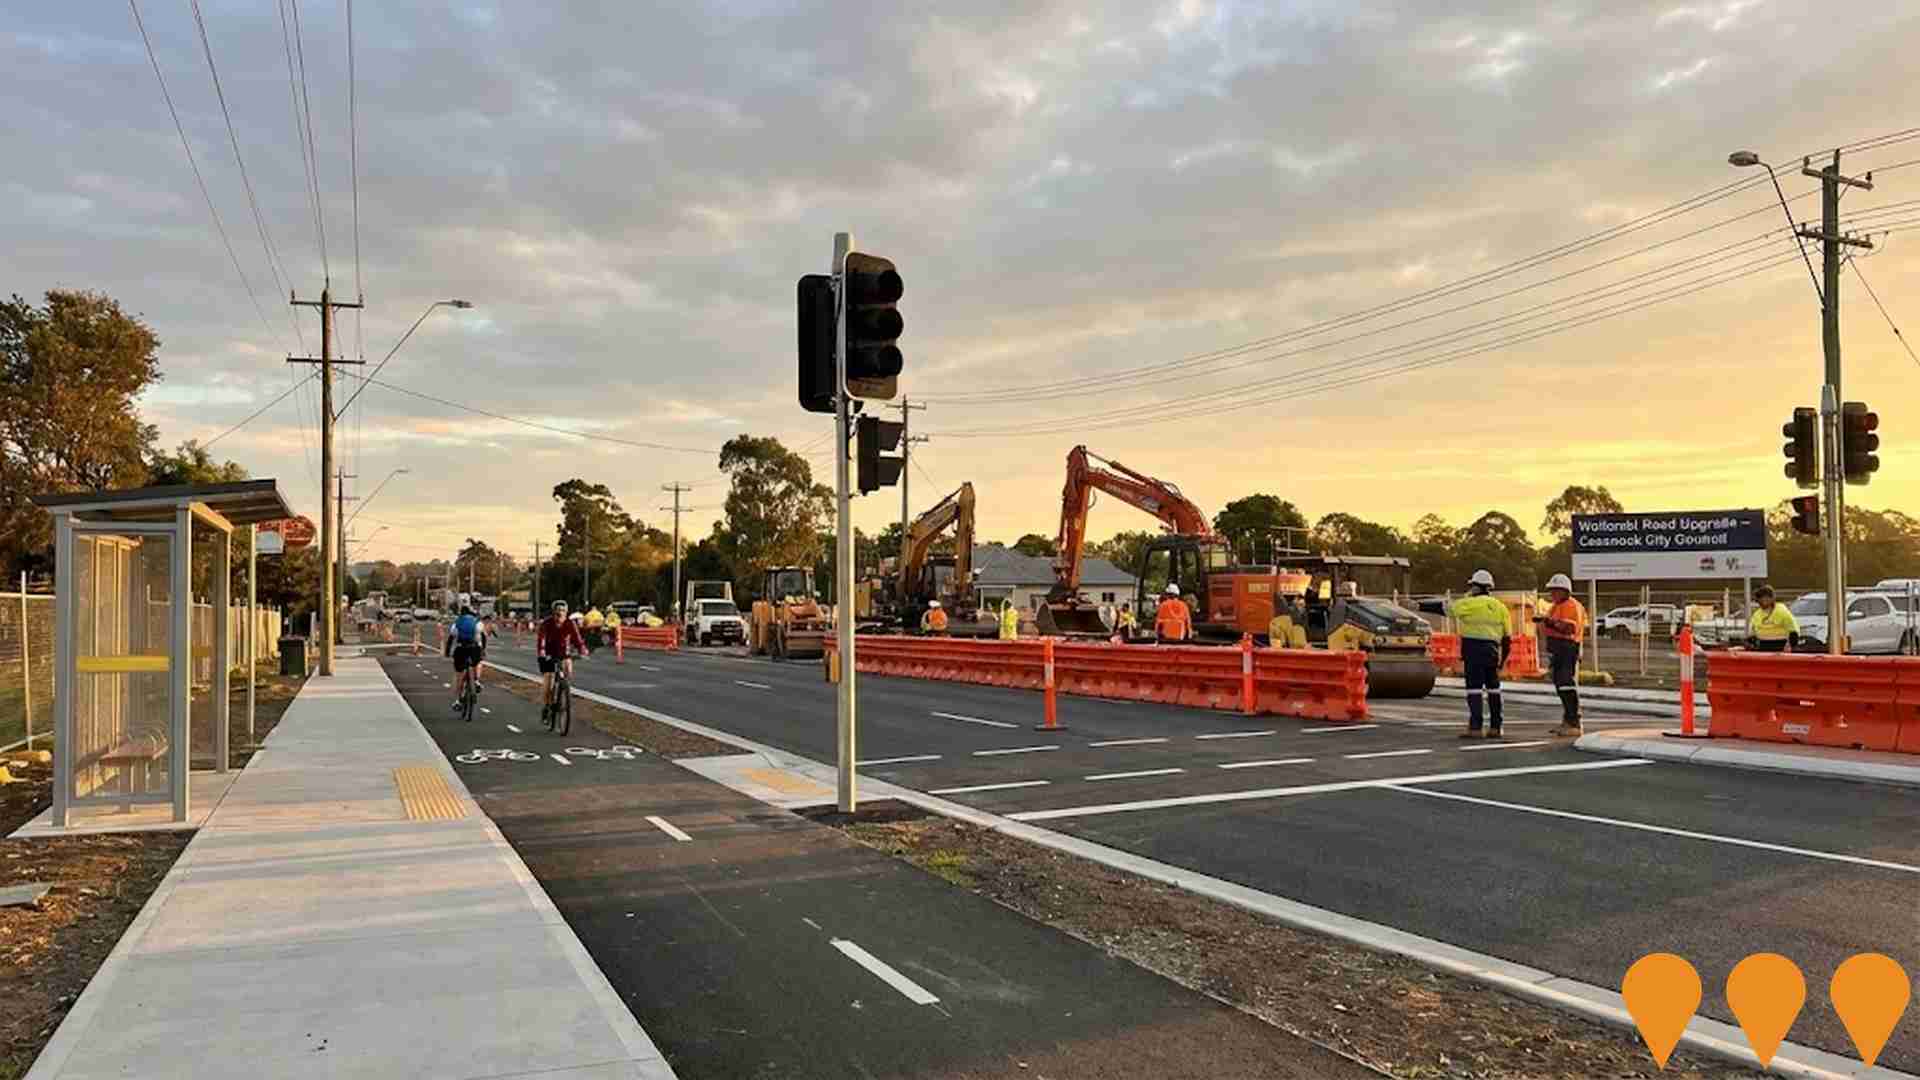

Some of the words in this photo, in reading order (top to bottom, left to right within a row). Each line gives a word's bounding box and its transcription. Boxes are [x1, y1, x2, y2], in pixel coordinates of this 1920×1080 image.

[1642, 518, 1676, 530] Road
[1680, 517, 1737, 532] Upgrade
[1580, 534, 1642, 546] Cessnock
[1645, 533, 1672, 548] City
[1674, 533, 1728, 546] Council
